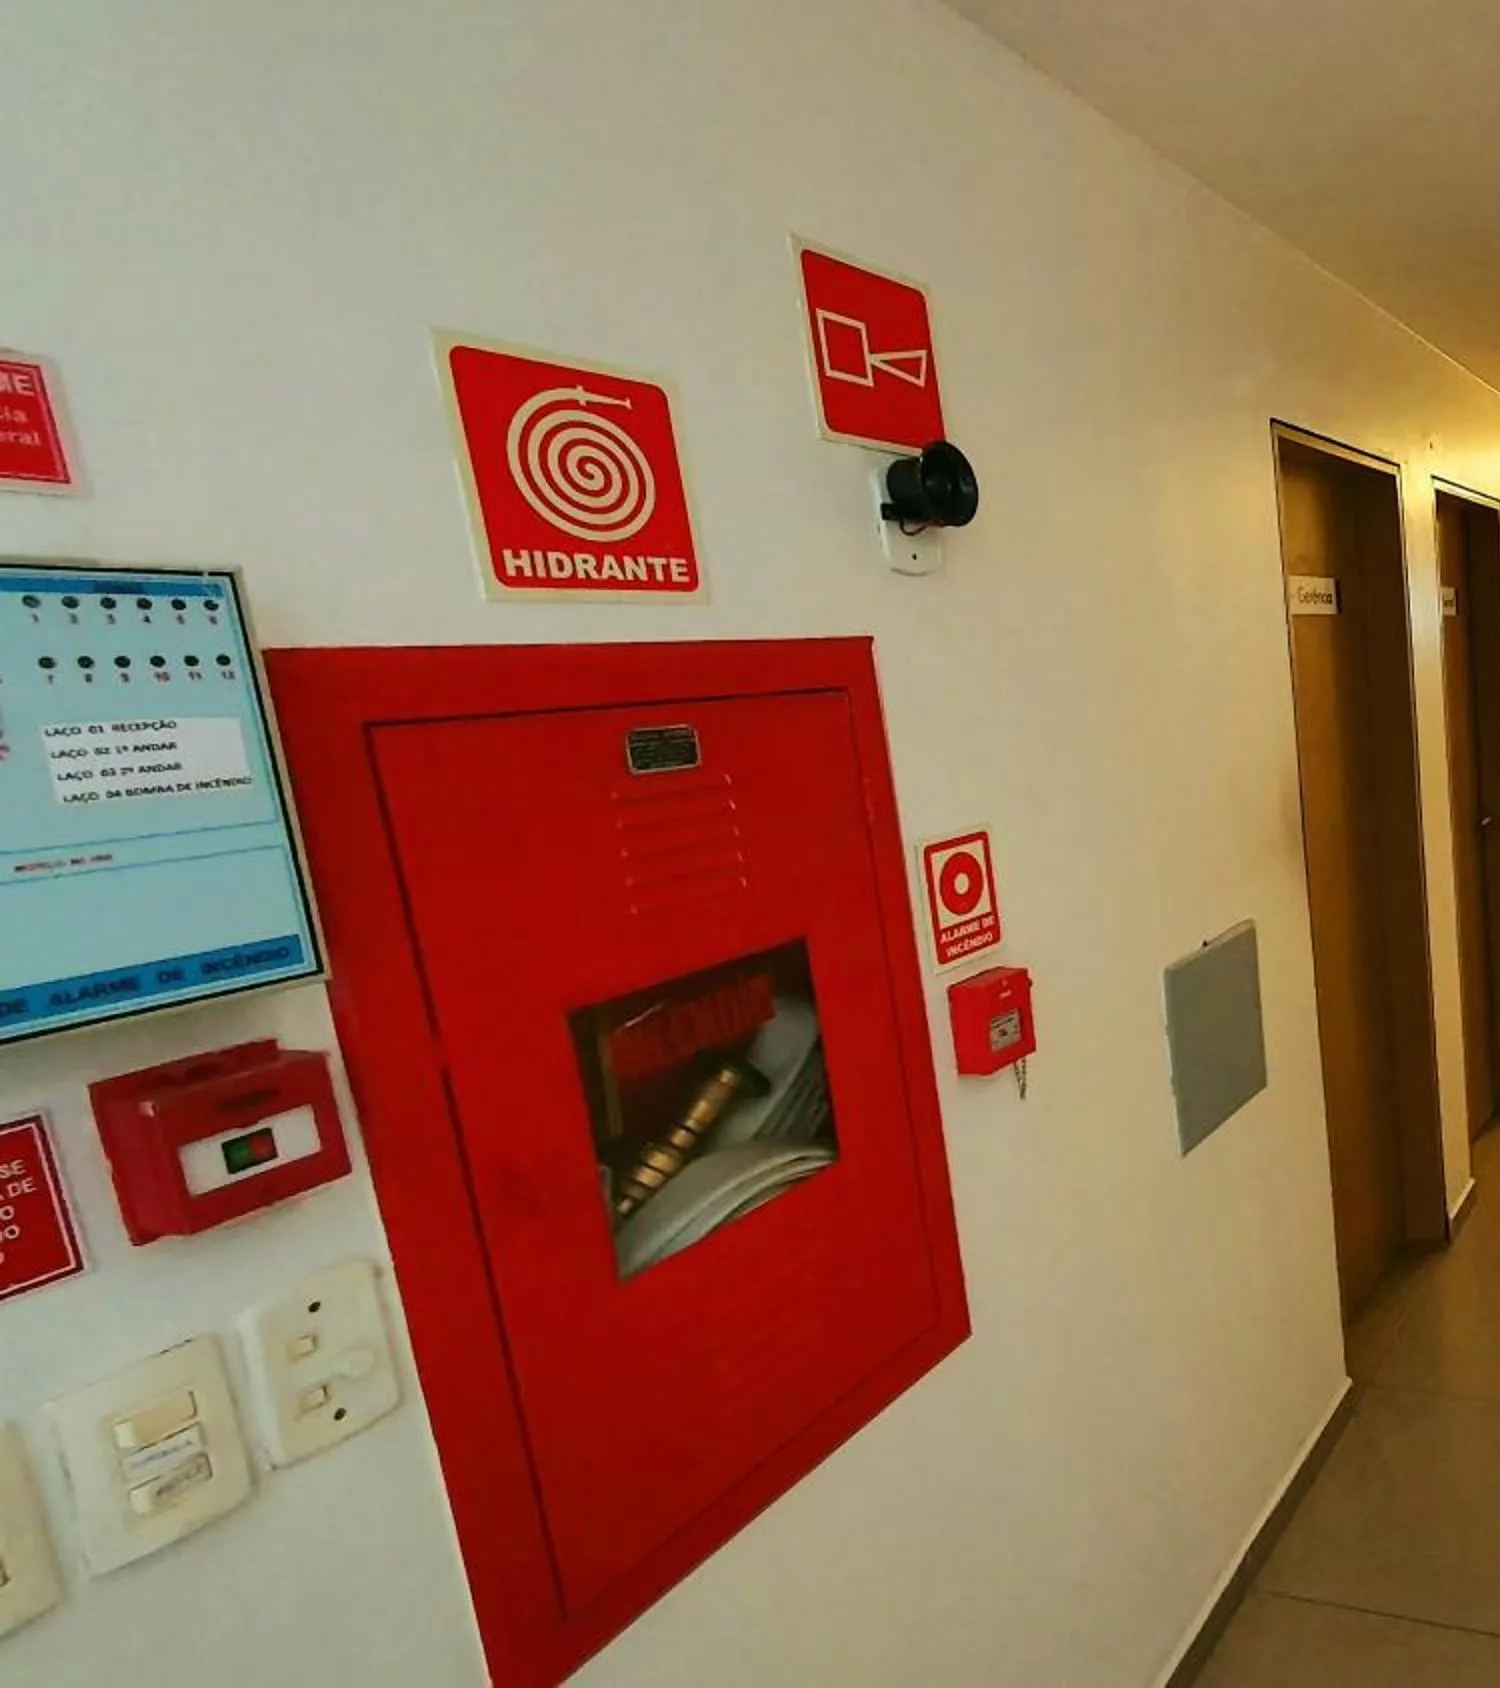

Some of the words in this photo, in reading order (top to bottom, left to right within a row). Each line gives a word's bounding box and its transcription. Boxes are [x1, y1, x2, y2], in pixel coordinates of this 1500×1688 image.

[502, 549, 691, 583] HIDRANTE
[45, 726, 82, 737] LAÇO
[52, 748, 88, 759] LAÇO
[133, 741, 177, 753] ANDAR
[57, 770, 94, 782] LAÇO
[138, 761, 182, 774] ANDAR
[63, 791, 99, 803] LAÇO
[940, 920, 981, 944] ALARME
[982, 915, 996, 929] DE
[946, 931, 993, 957] INCÊNDIO
[49, 976, 140, 1007] ALARME
[158, 967, 185, 985] DE
[7, 1177, 37, 1199] DE
